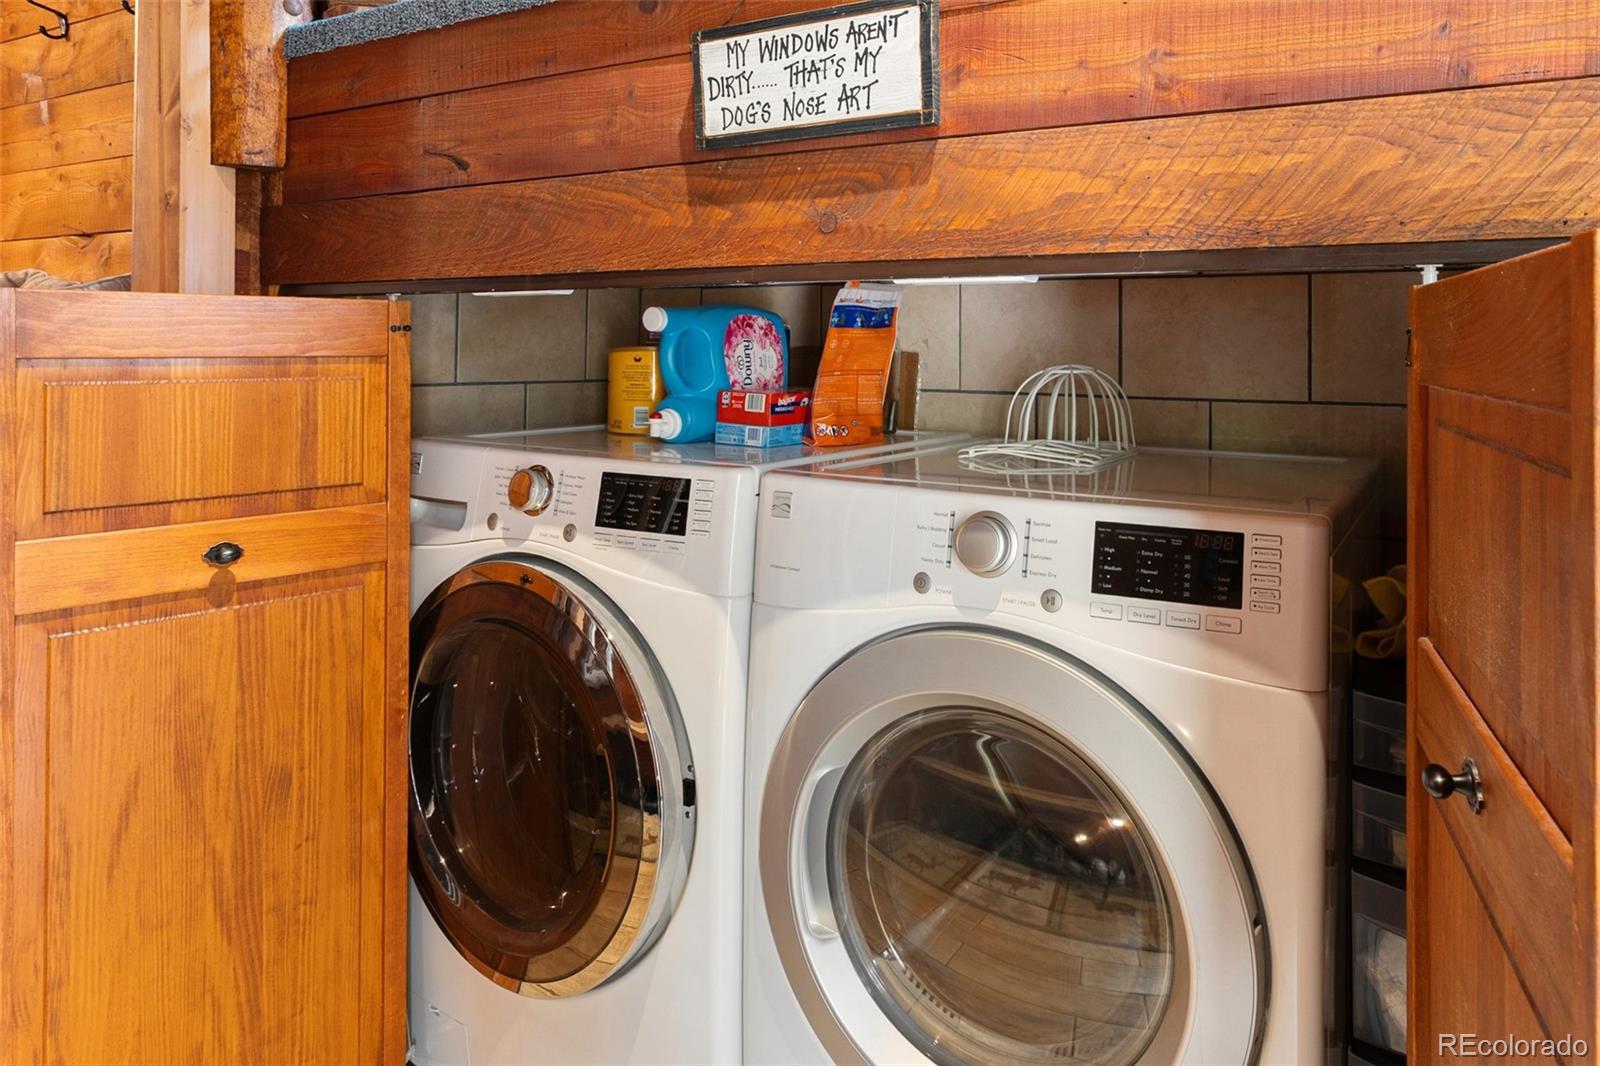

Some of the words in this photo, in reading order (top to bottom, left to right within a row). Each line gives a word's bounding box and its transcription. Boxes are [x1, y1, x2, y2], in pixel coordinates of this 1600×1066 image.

[727, 39, 750, 69] MY
[759, 24, 839, 63] WINDOWS
[845, 10, 909, 50] AREN'T
[784, 53, 846, 88] THAT'S
[854, 45, 883, 77] MY
[721, 101, 771, 130] DOG'S
[783, 91, 827, 122] NOSE
[837, 79, 879, 115] ART
[743, 339, 753, 387] Downy
